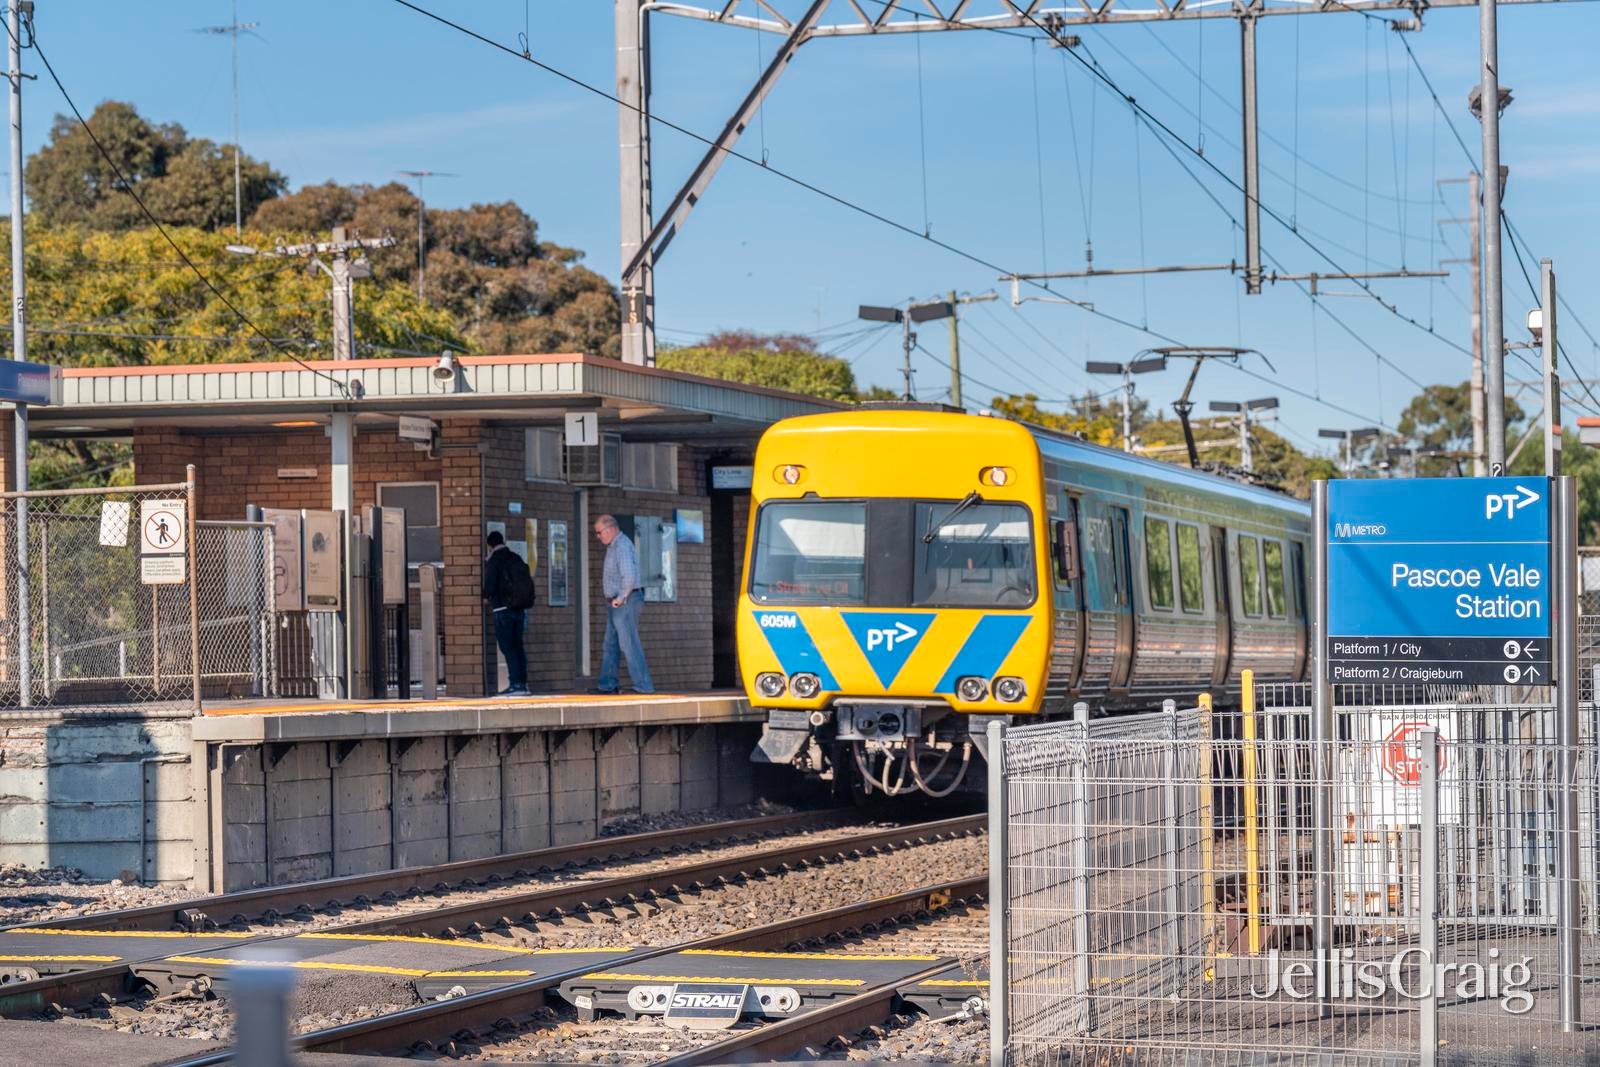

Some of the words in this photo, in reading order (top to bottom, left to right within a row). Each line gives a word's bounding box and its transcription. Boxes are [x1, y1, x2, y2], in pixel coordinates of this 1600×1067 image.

[575, 416, 586, 442] 1
[1352, 525, 1386, 535] METRO
[1392, 564, 1481, 588] Pascoe
[1488, 563, 1540, 588] Vale
[1455, 594, 1541, 618] Station
[760, 615, 796, 628] 605M
[1334, 643, 1380, 655] Platform
[1383, 644, 1388, 655] 1
[1392, 643, 1398, 655] /
[1400, 643, 1422, 658] City
[1334, 667, 1380, 679] Platform
[1383, 667, 1390, 679] 2
[1392, 667, 1398, 679] /
[1400, 667, 1463, 682] Craigieburn
[672, 994, 741, 1008] STRAIL
